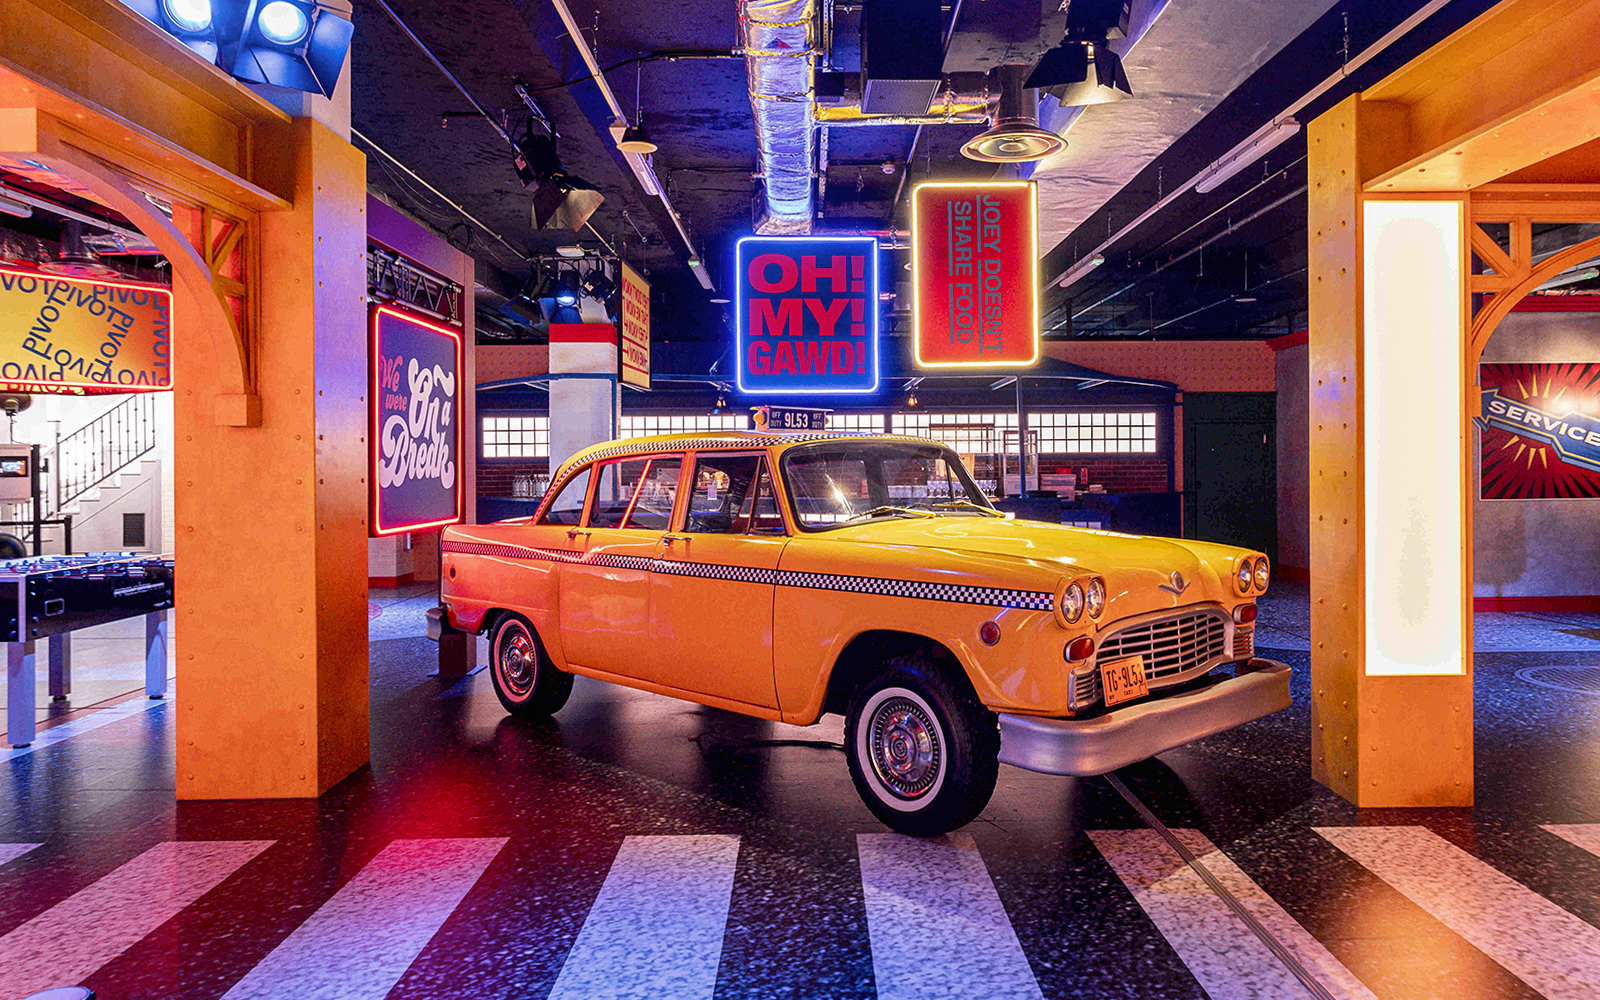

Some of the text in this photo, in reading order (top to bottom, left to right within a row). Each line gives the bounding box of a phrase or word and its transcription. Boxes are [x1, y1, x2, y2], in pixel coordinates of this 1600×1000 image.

[748, 253, 865, 293] OH!
[954, 201, 974, 344] SHARE FOOD
[983, 195, 1002, 354] JOEY DOESN'T
[51, 281, 122, 323] PIVOT
[748, 298, 865, 336] MY!
[22, 291, 66, 354] PIVOT
[95, 309, 135, 373] PIVOT
[37, 343, 108, 383] PIVOT
[379, 355, 403, 392] We
[748, 340, 865, 375] GAWD!
[385, 394, 407, 411] were
[771, 411, 782, 419] OFF
[784, 412, 809, 428] 9L53
[770, 420, 782, 428] DUTY
[380, 415, 455, 489] Break
